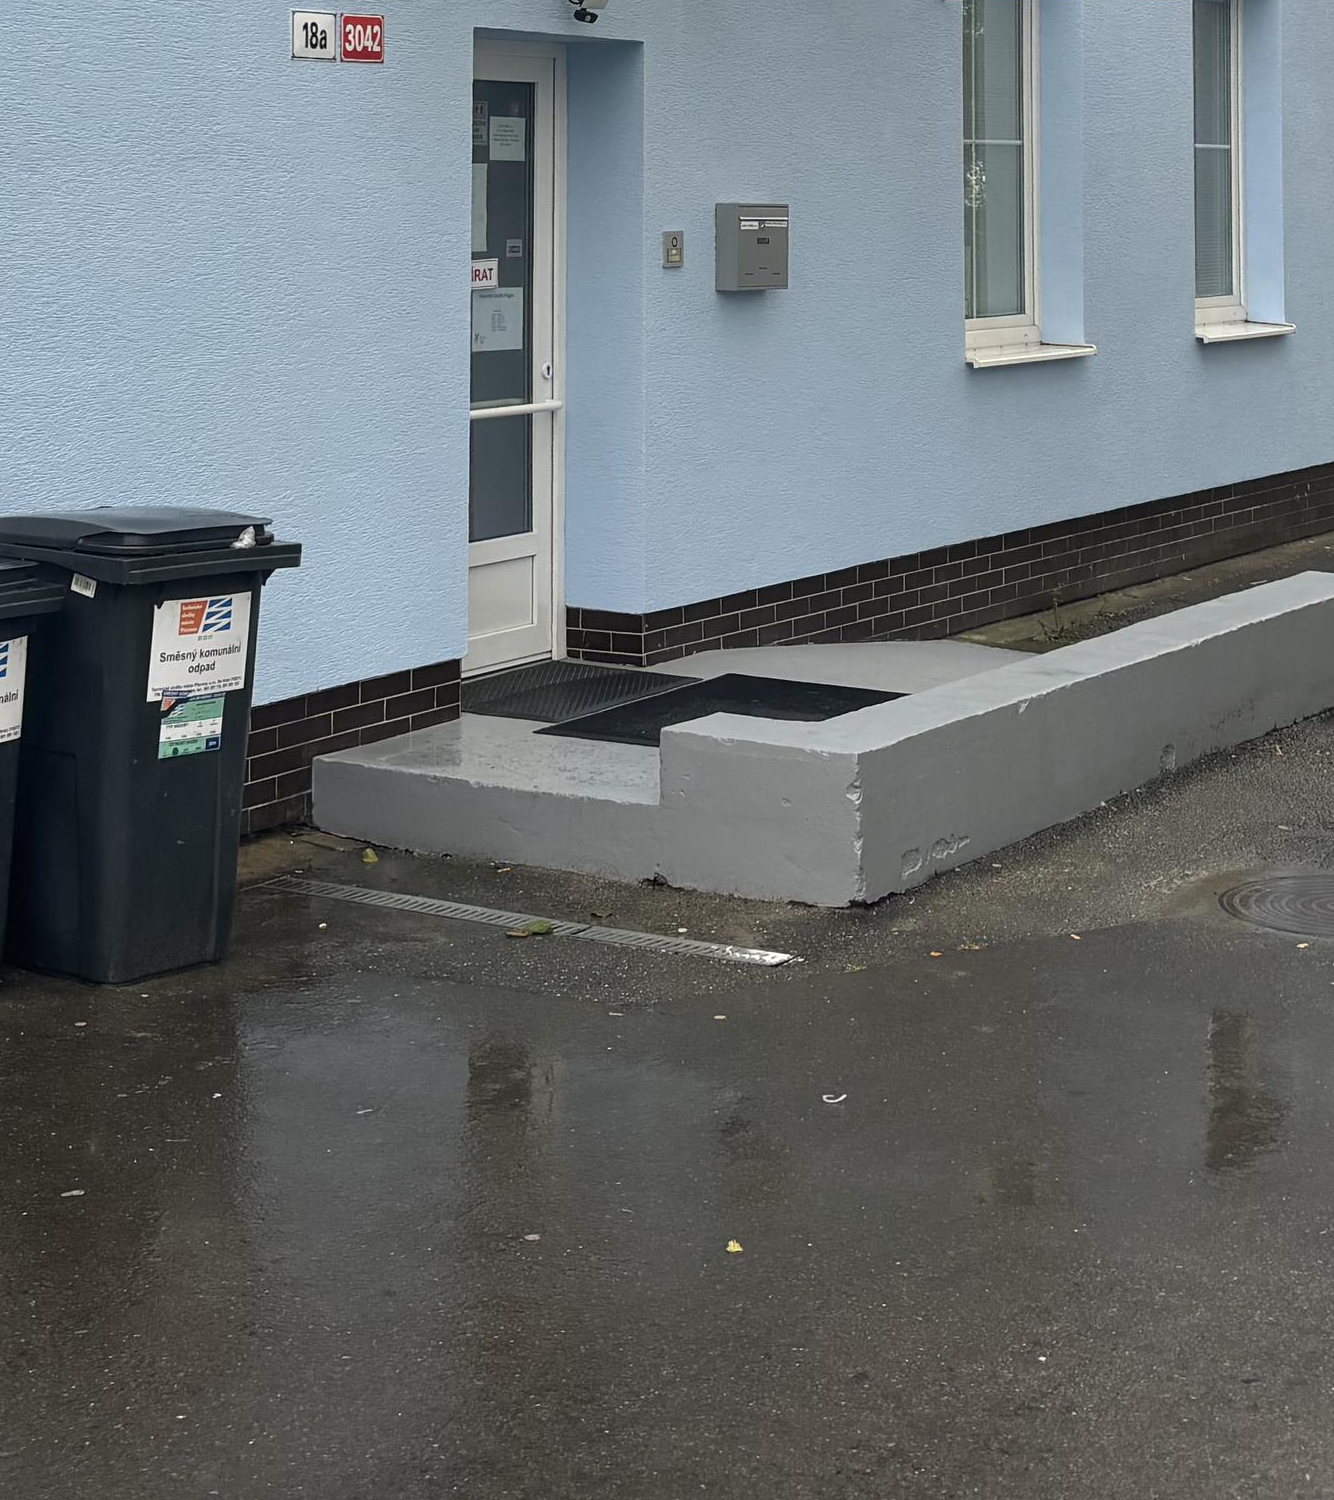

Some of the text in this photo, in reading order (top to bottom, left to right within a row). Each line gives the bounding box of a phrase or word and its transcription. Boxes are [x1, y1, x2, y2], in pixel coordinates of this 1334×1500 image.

[302, 21, 327, 50] 18a
[345, 24, 381, 52] 3042
[159, 641, 242, 663] Směsný komunální
[188, 661, 216, 675] odpad
